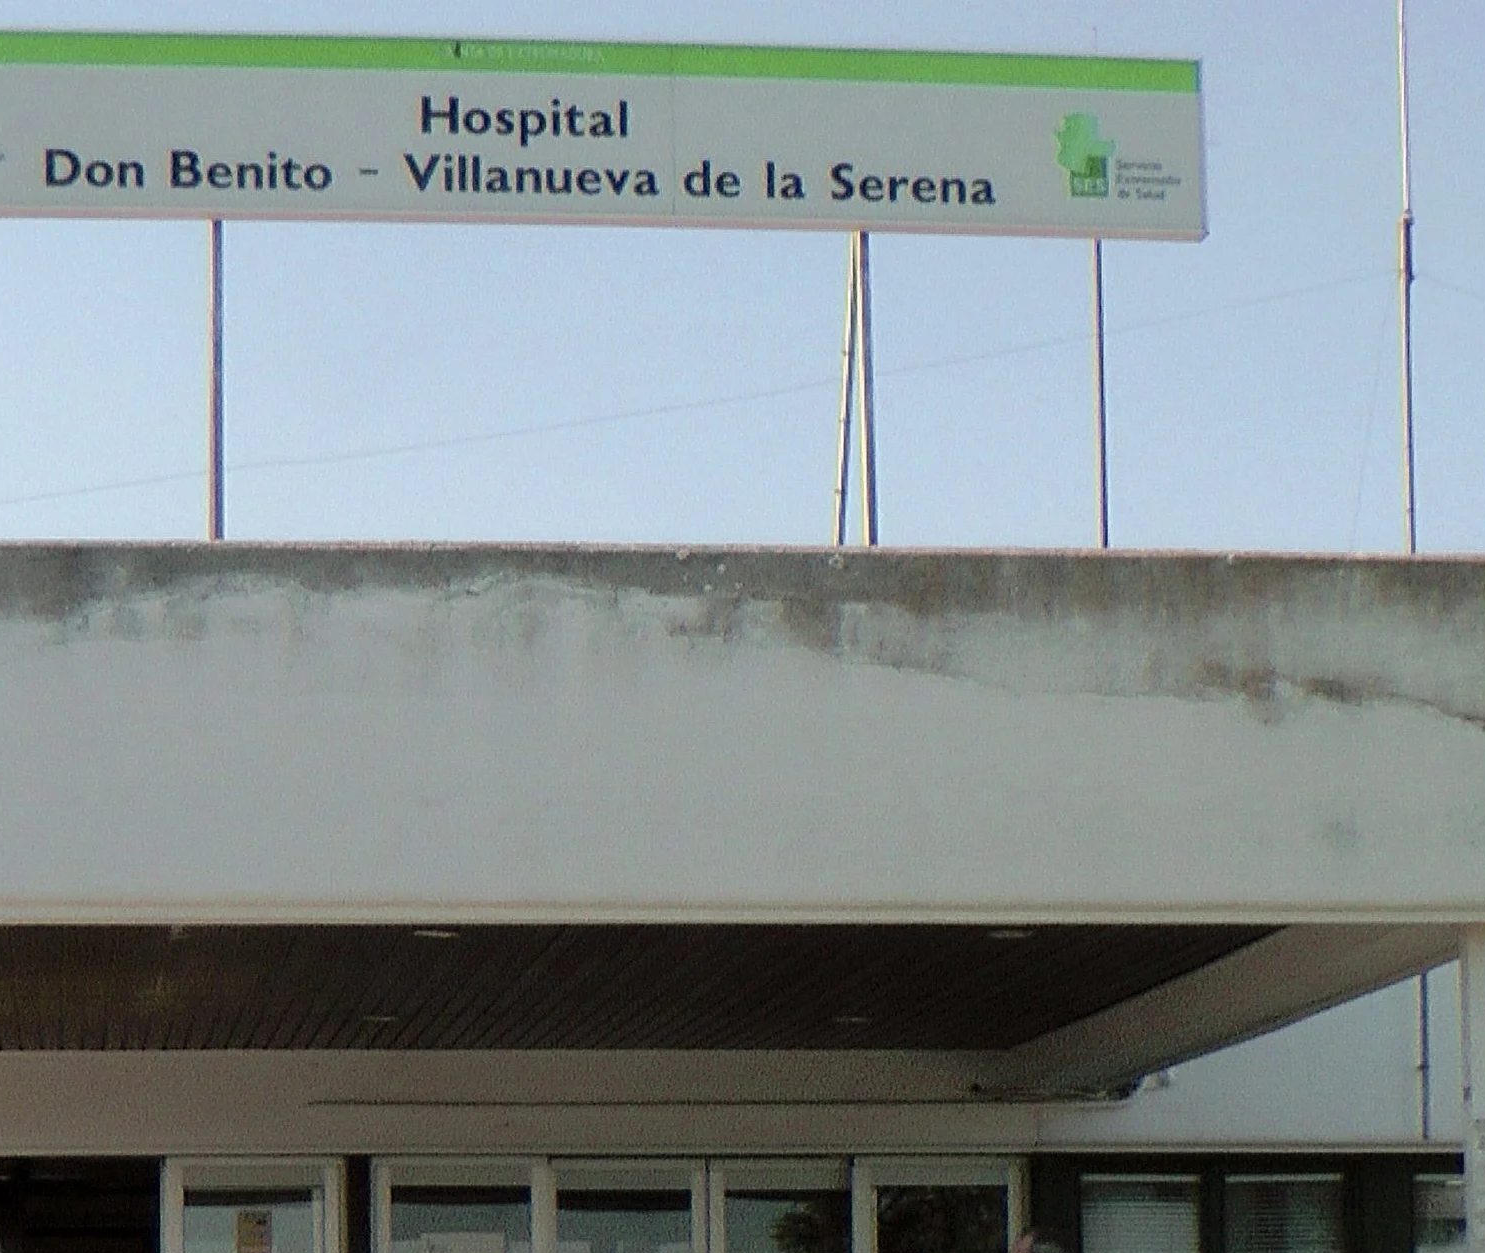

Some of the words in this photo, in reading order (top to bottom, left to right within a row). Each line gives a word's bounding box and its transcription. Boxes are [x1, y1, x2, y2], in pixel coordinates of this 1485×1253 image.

[420, 95, 629, 147] Hospital
[44, 148, 146, 189] Don
[170, 149, 333, 191] Benito
[403, 153, 660, 197] Villanueva
[683, 159, 742, 199] de
[764, 160, 806, 200] la
[830, 162, 997, 205] Serena
